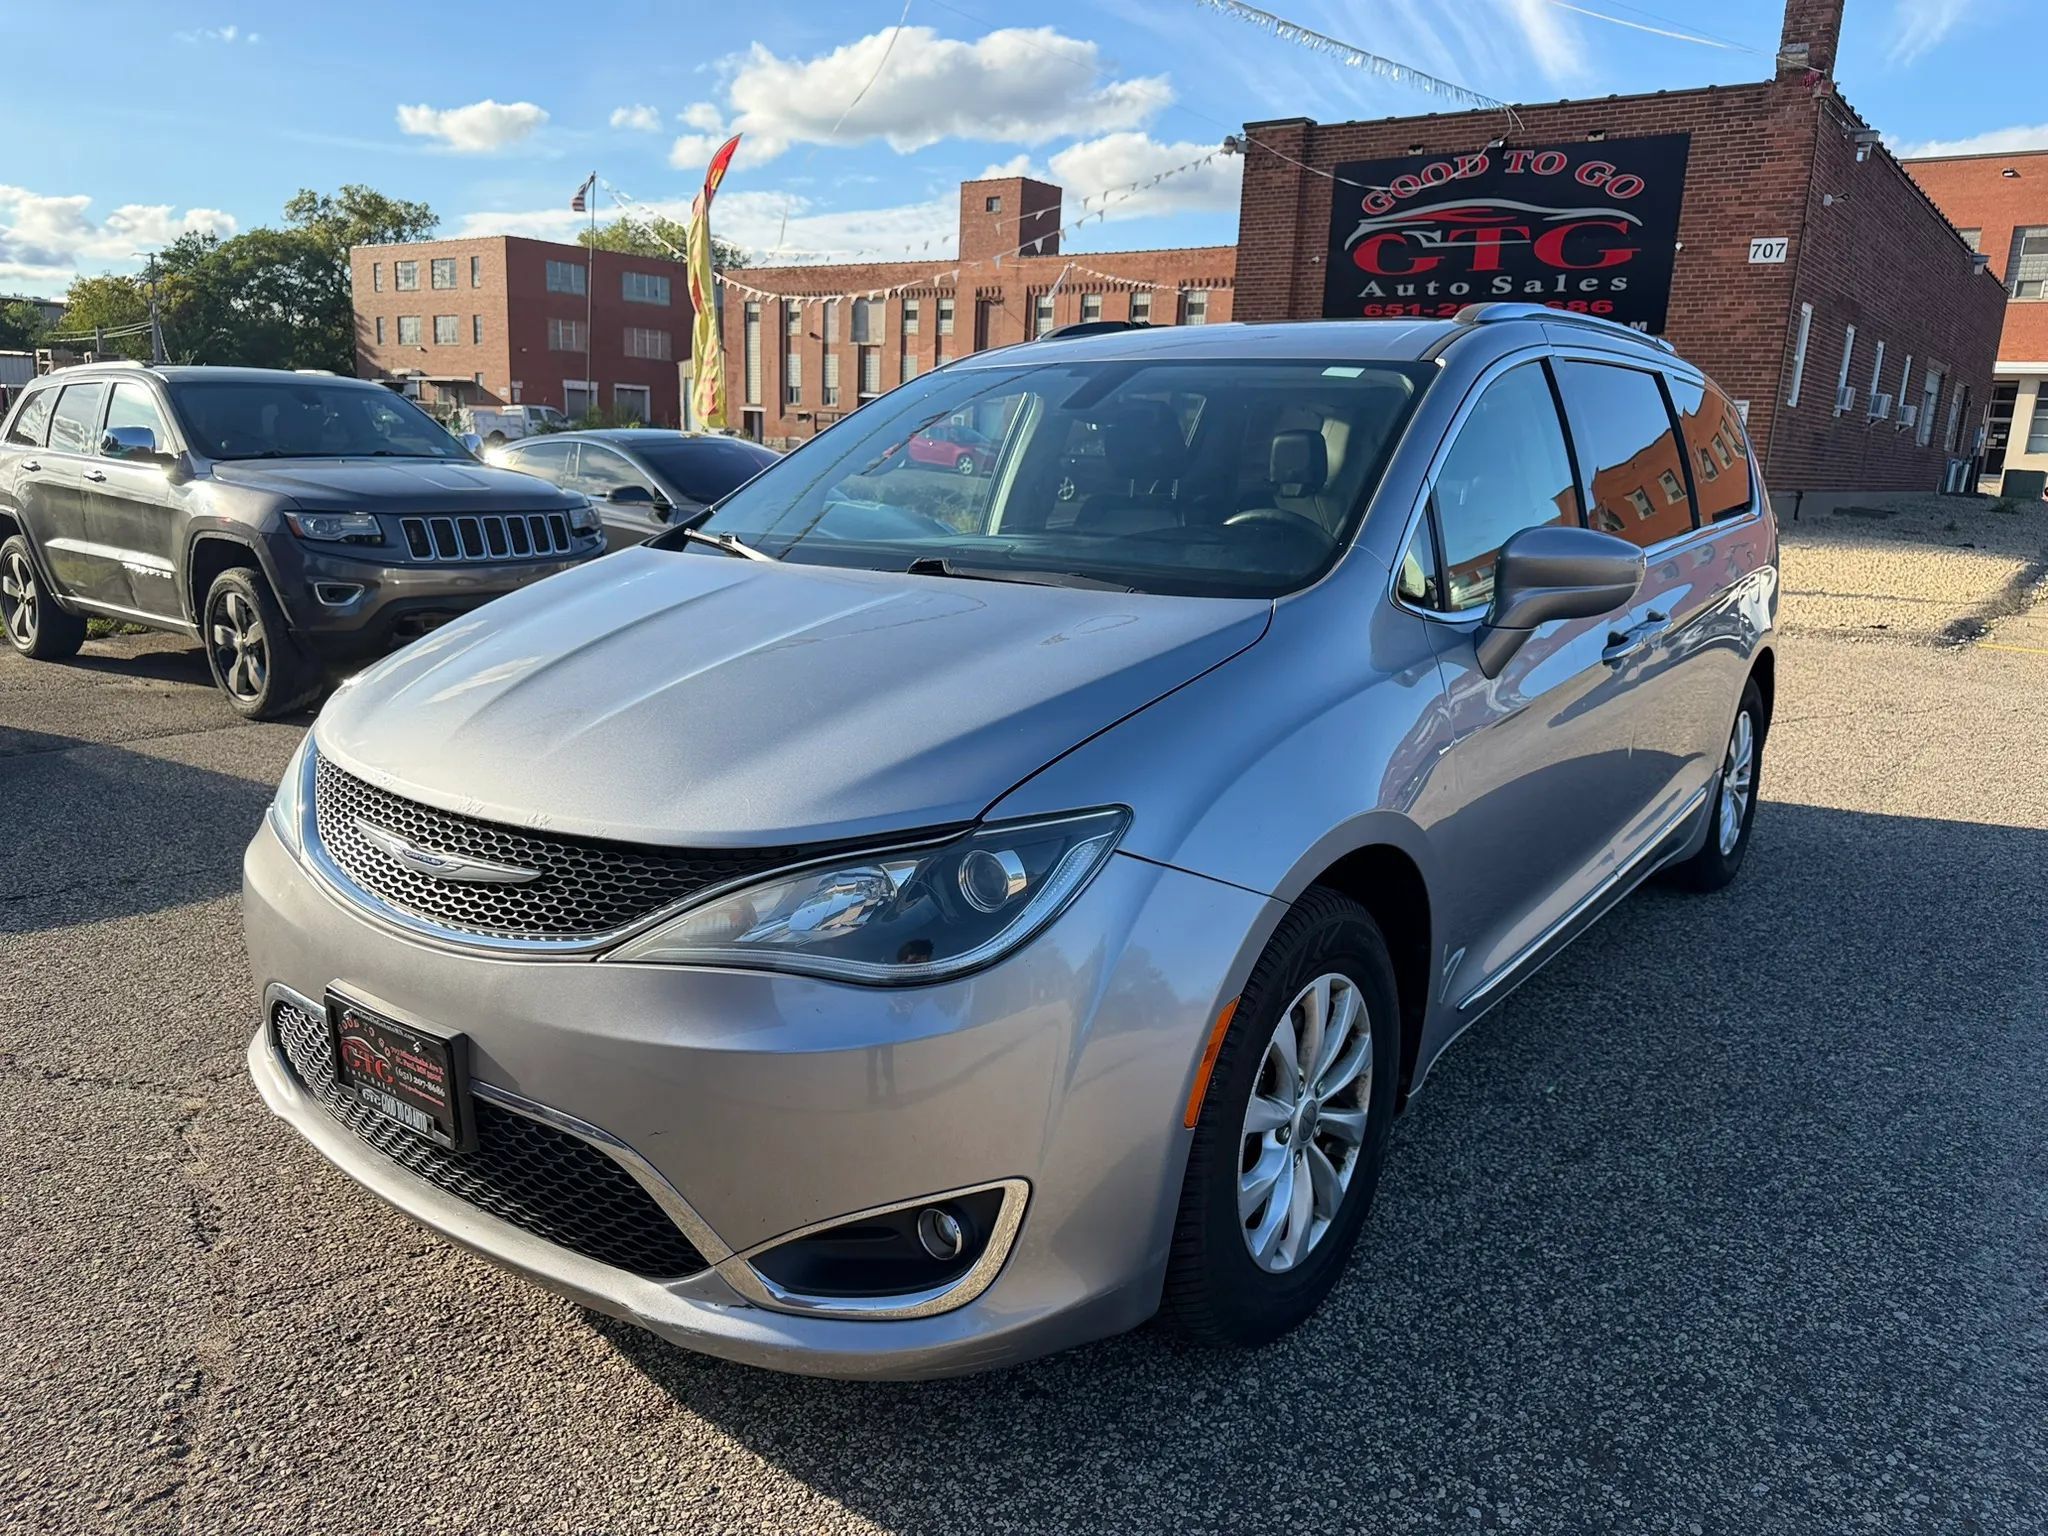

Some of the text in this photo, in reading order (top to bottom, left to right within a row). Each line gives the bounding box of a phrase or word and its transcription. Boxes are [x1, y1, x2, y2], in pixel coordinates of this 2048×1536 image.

[1361, 150, 1645, 215] GOOD TO GO
[1353, 221, 1641, 276] GTG
[1752, 243, 1786, 259] 707
[1357, 273, 1628, 298] Auto Sales
